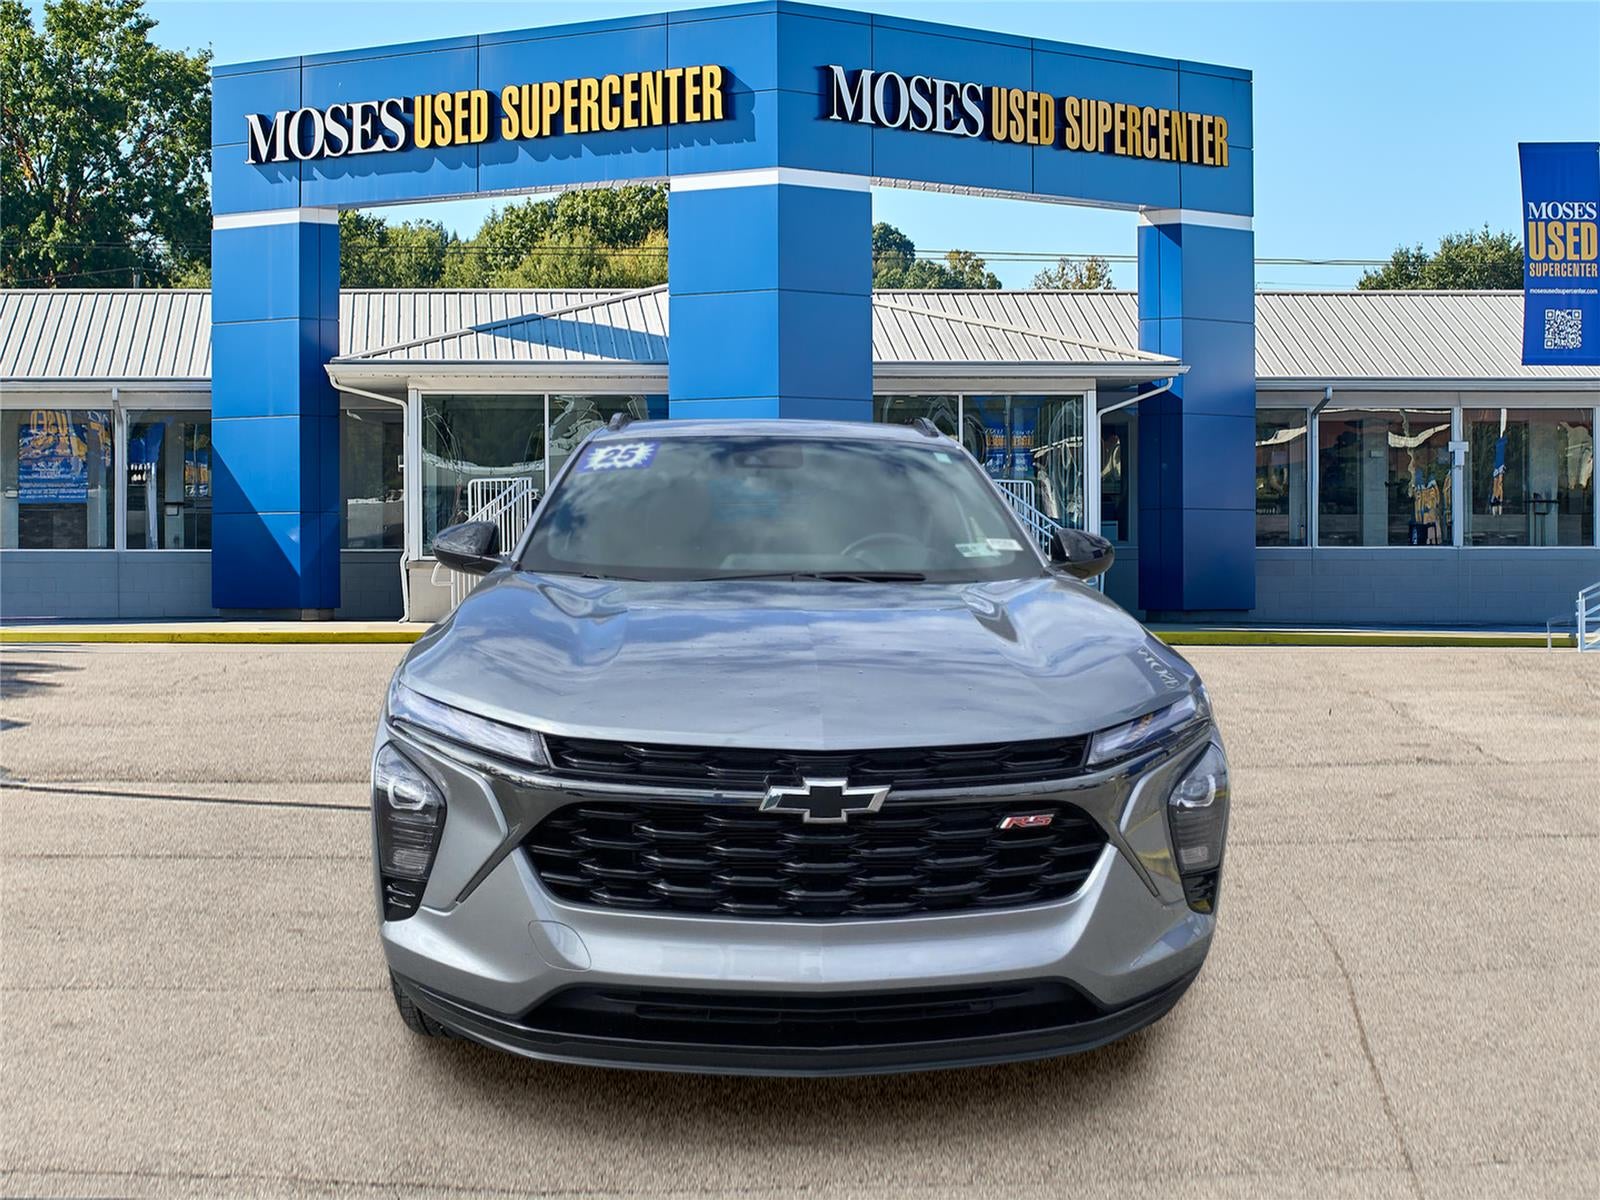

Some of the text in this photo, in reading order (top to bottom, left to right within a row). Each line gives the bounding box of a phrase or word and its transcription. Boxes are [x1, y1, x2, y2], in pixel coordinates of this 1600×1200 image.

[244, 64, 724, 165] MOSES USED SUPERCENTER
[828, 64, 1230, 167] MOSES USED SUPERCENTER
[1527, 201, 1597, 220] MOSES
[1528, 221, 1598, 261] USED
[1529, 263, 1598, 277] SUPERCENTER
[598, 448, 638, 463] 25
[1000, 814, 1054, 829] RS
